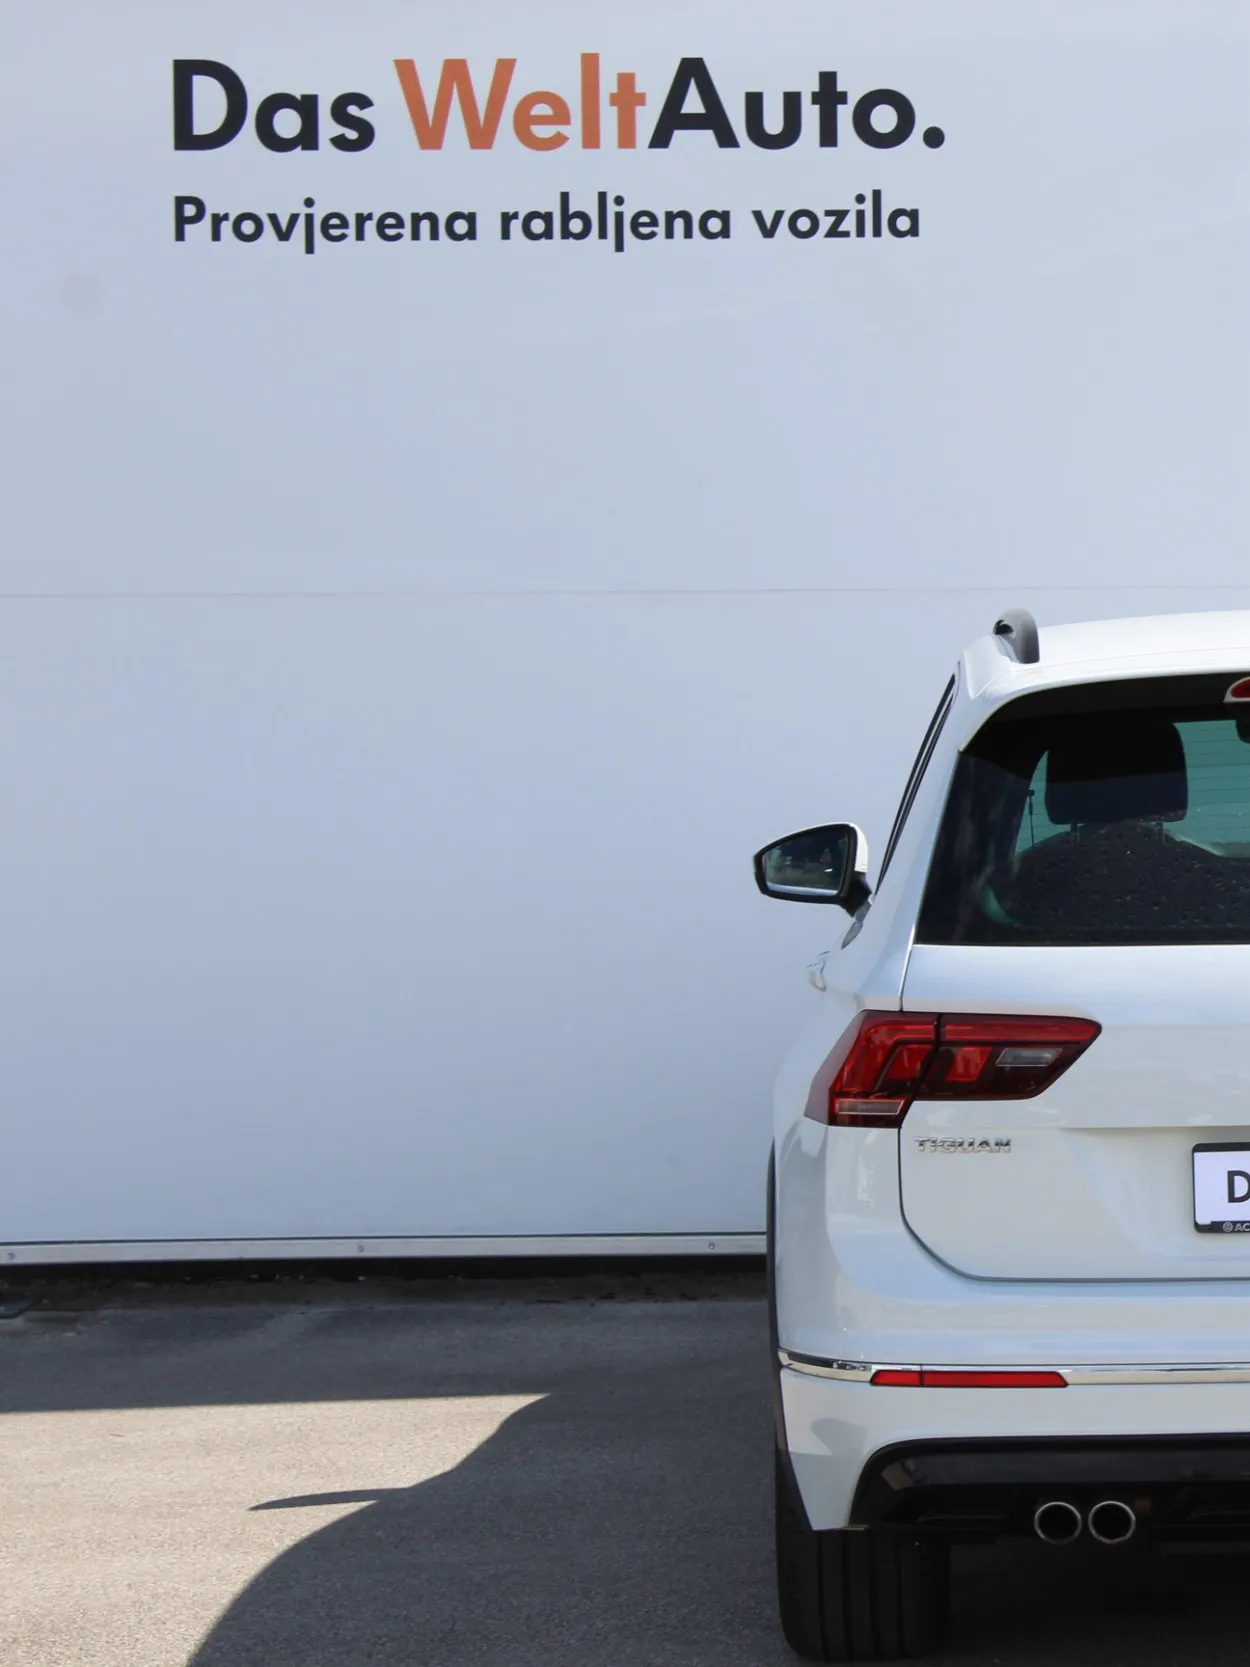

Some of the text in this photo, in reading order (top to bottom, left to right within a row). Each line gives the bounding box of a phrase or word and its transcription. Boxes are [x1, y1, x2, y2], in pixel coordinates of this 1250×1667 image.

[172, 53, 945, 153] Das WeltAuto.
[174, 189, 919, 254] Provjerena rabljena vozila
[914, 1136, 1012, 1154] TIGUAN
[1234, 1222, 1250, 1232] AC
